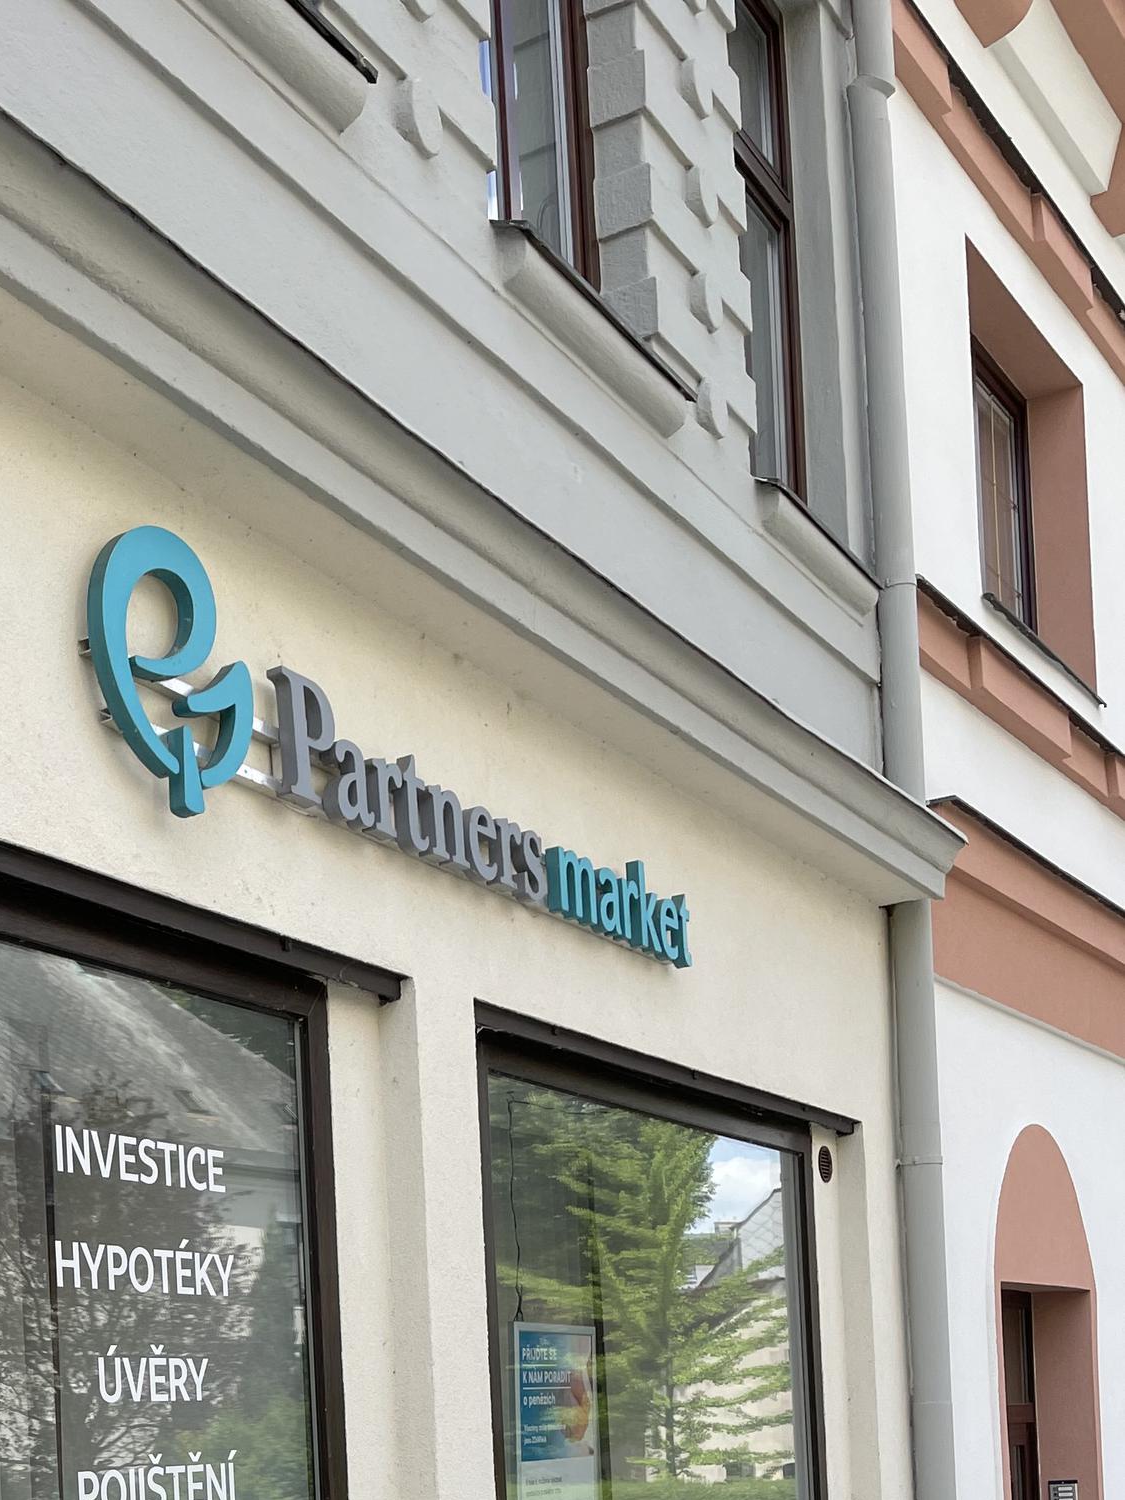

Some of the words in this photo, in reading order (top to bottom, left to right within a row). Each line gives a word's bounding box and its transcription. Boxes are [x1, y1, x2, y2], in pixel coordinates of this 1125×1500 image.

[267, 665, 547, 901] Partners
[545, 846, 692, 968] market
[54, 1125, 226, 1194] INVESTICE
[55, 1240, 234, 1297] HYPOTÉKY
[97, 1344, 209, 1404] ÚVĚRY
